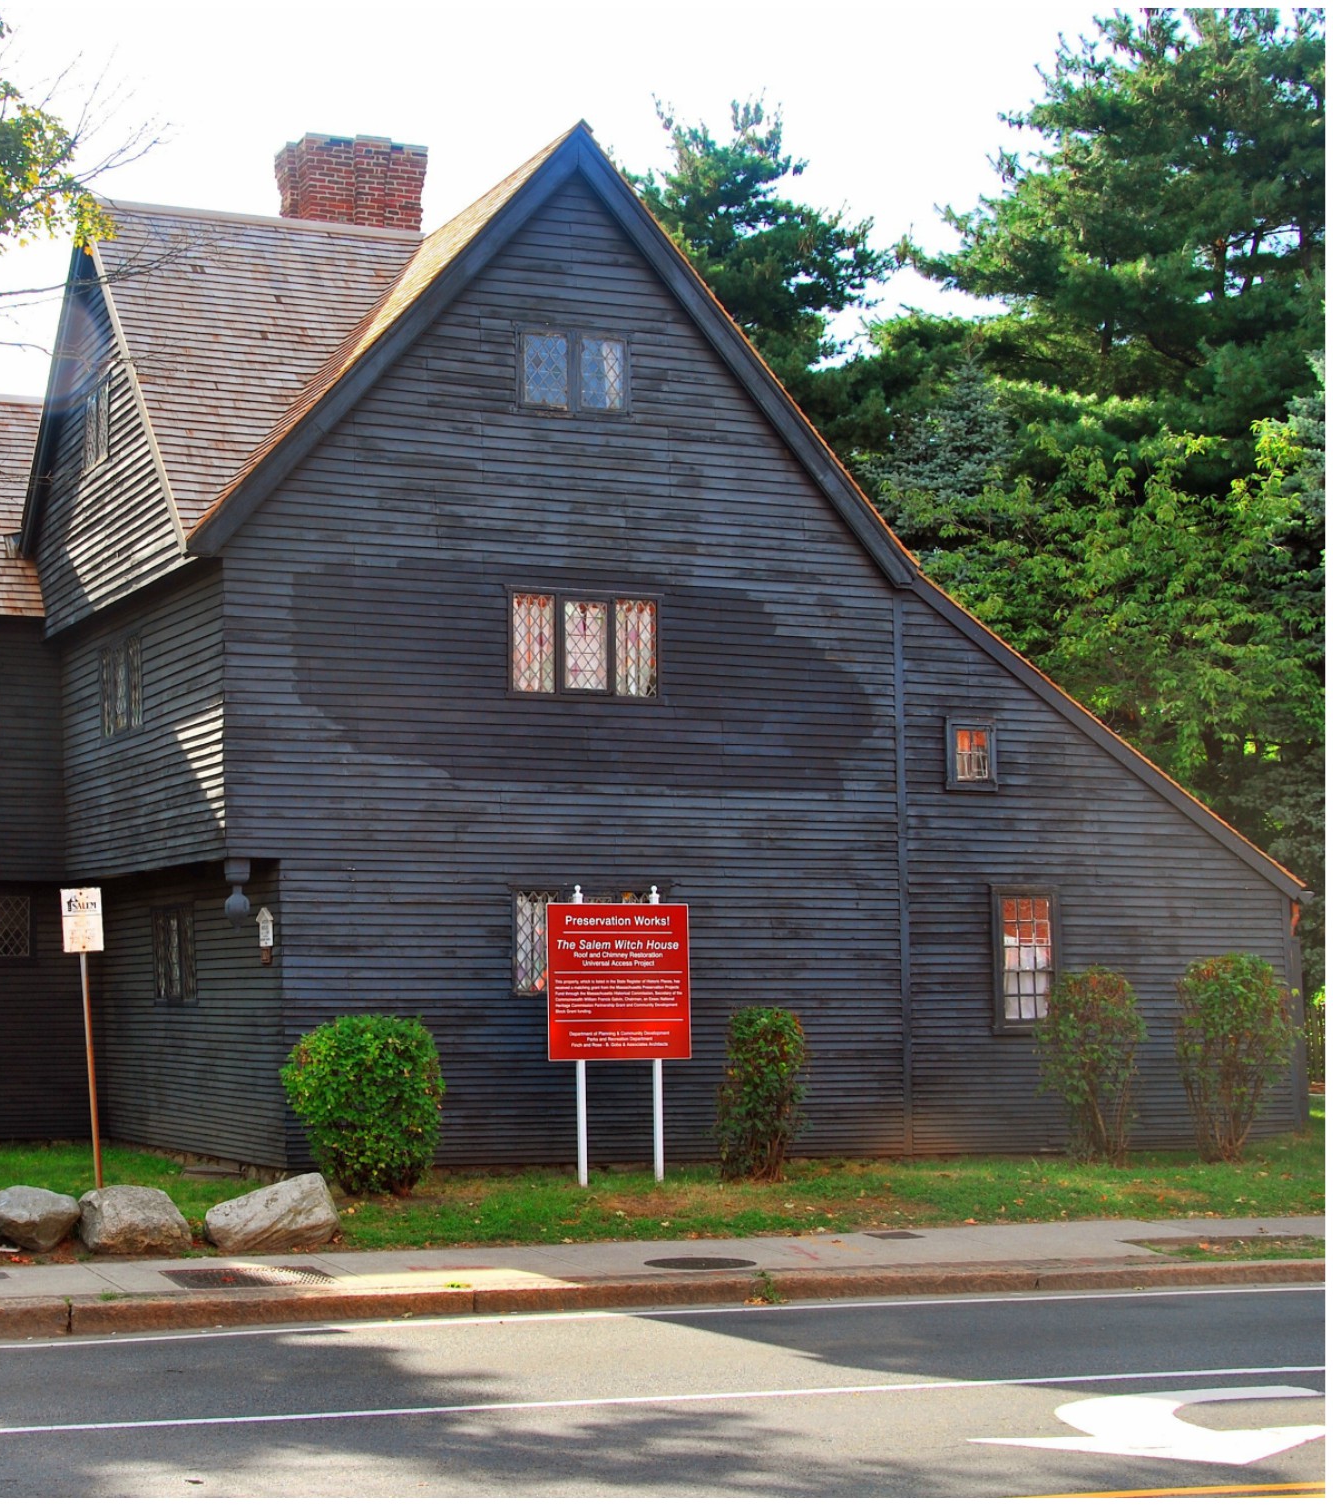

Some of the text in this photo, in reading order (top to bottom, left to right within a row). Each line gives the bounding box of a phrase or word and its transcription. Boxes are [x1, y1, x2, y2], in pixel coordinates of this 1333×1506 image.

[565, 915, 670, 926] Preservation Works!
[557, 939, 680, 950] The Salem Witch House
[602, 951, 628, 959] Chimney
[633, 960, 655, 968] Project
